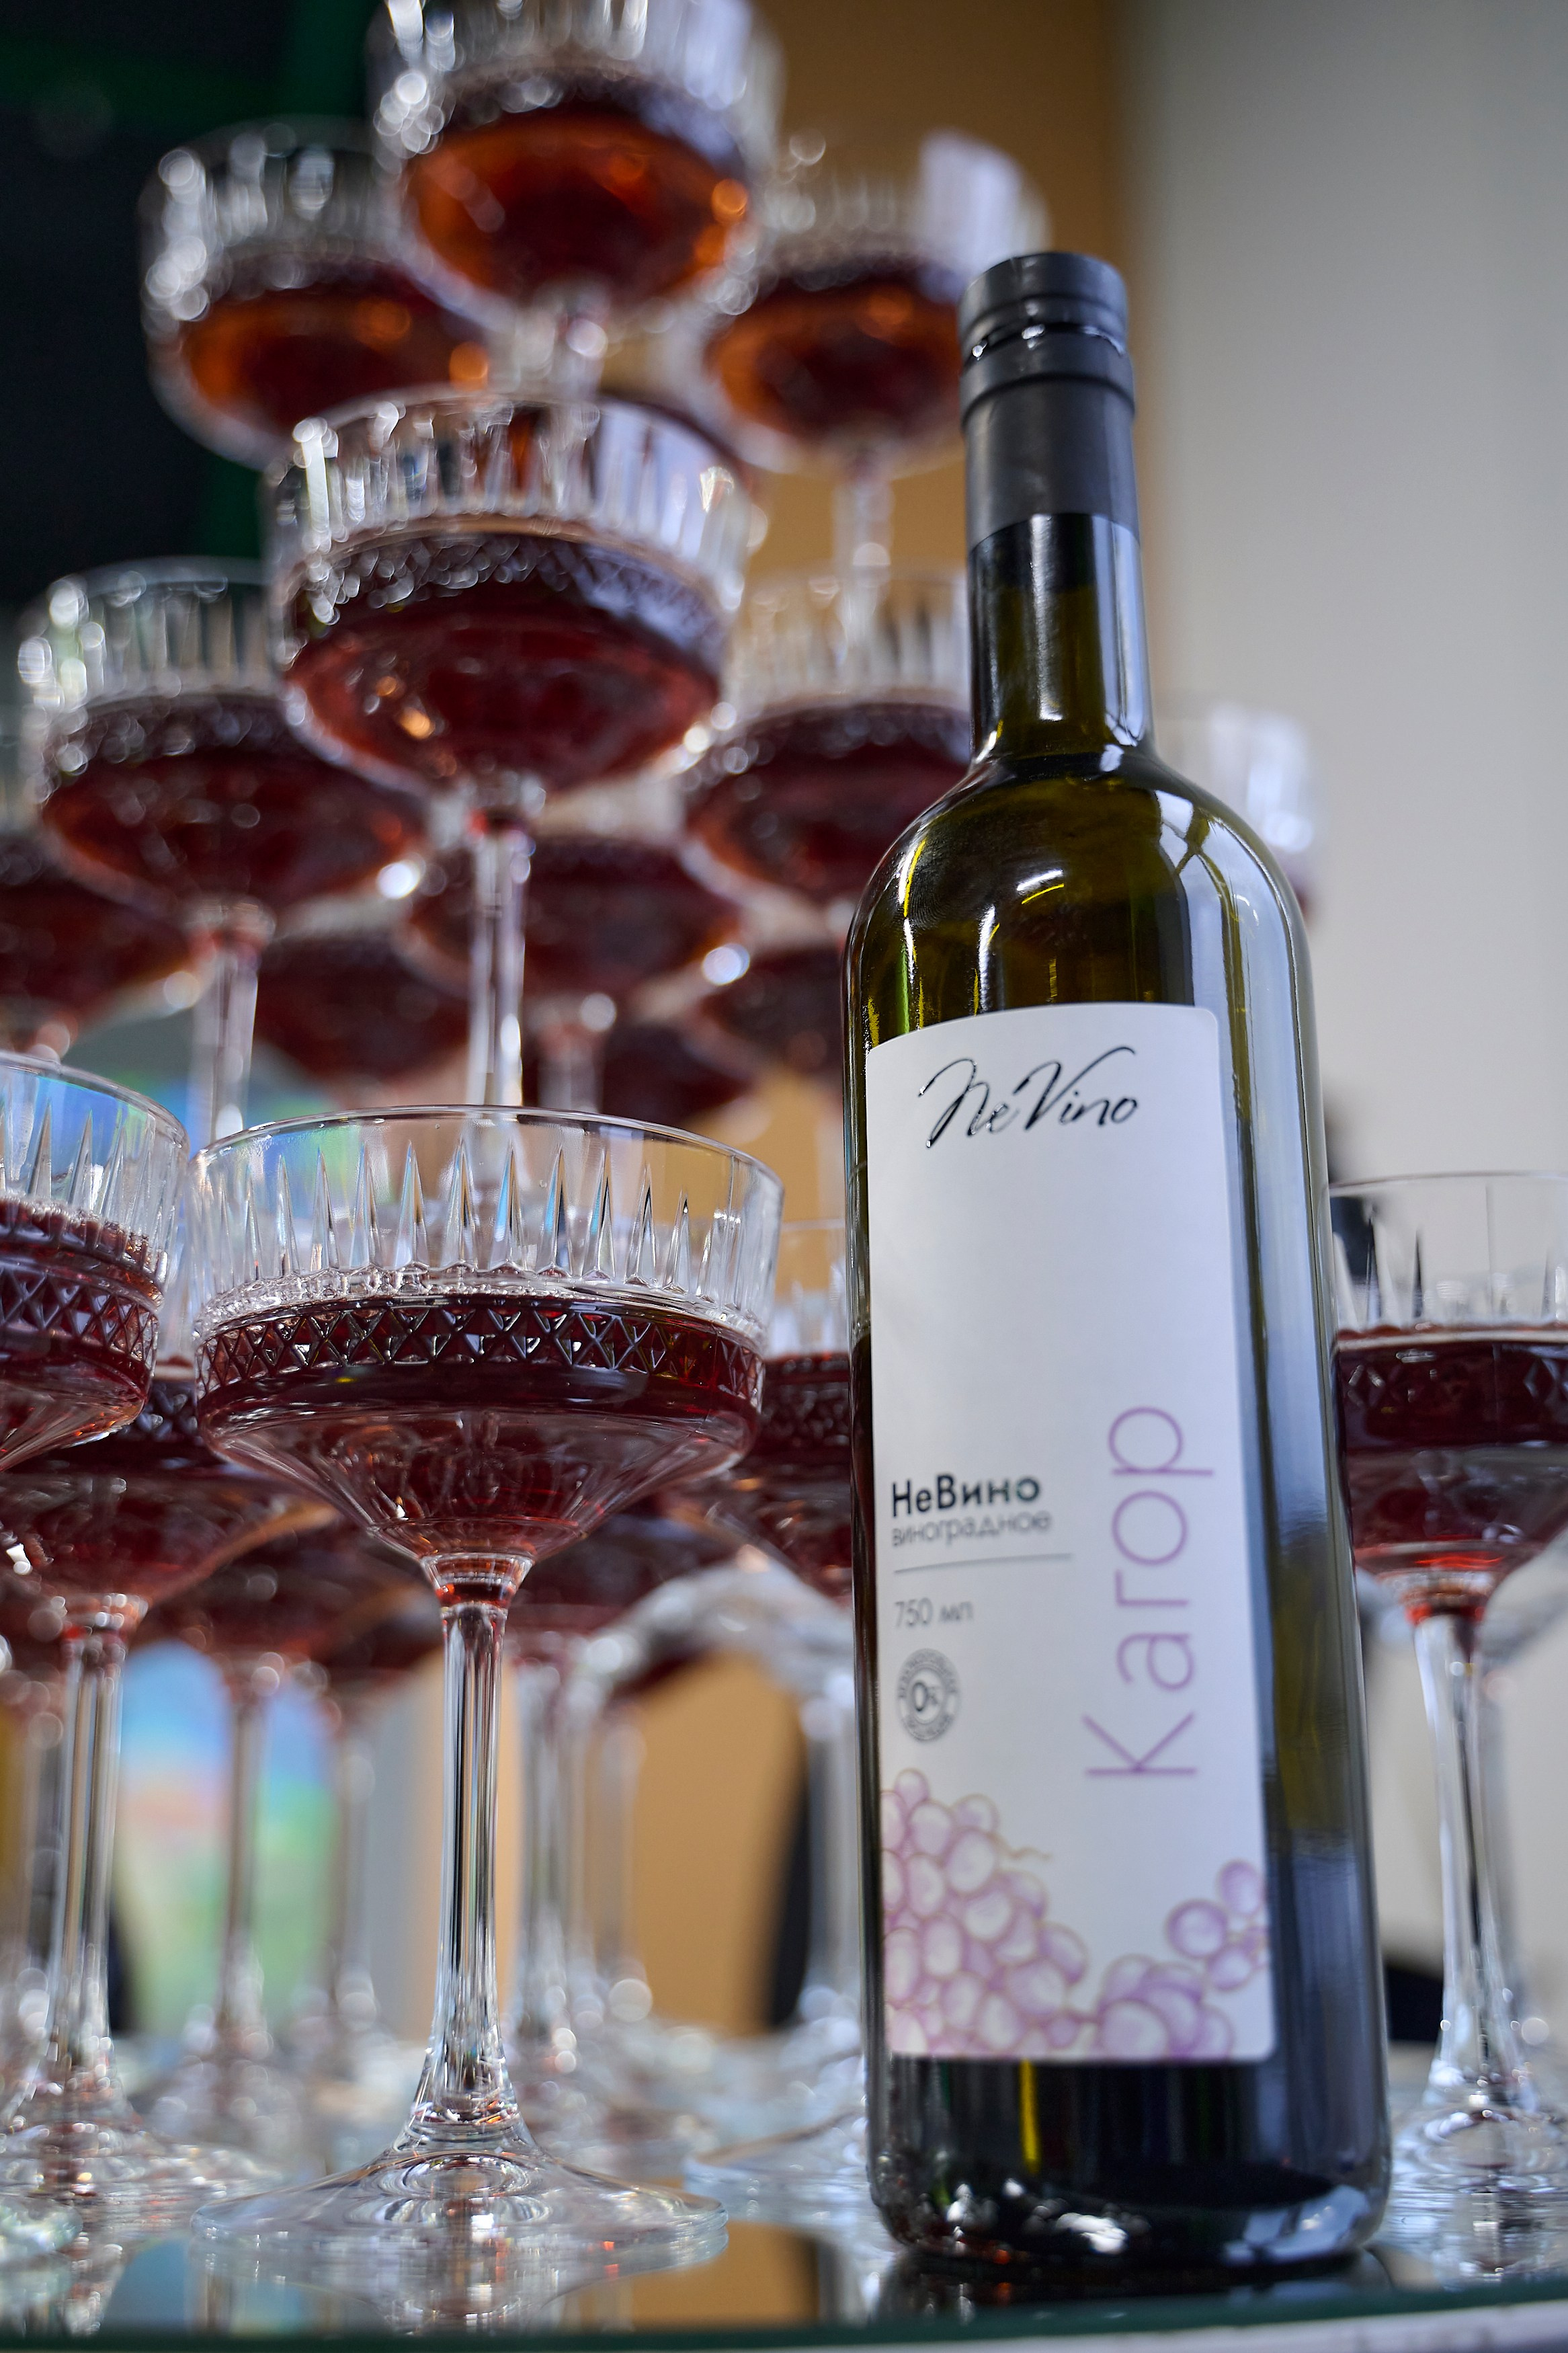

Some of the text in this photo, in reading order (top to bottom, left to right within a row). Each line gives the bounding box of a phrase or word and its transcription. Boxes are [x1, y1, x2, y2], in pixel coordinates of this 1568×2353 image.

[892, 1474, 1040, 1518] НеВино
[891, 1511, 1052, 1548] виноградное
[1082, 1406, 1213, 1778] Кагор
[894, 1597, 934, 1628] 750
